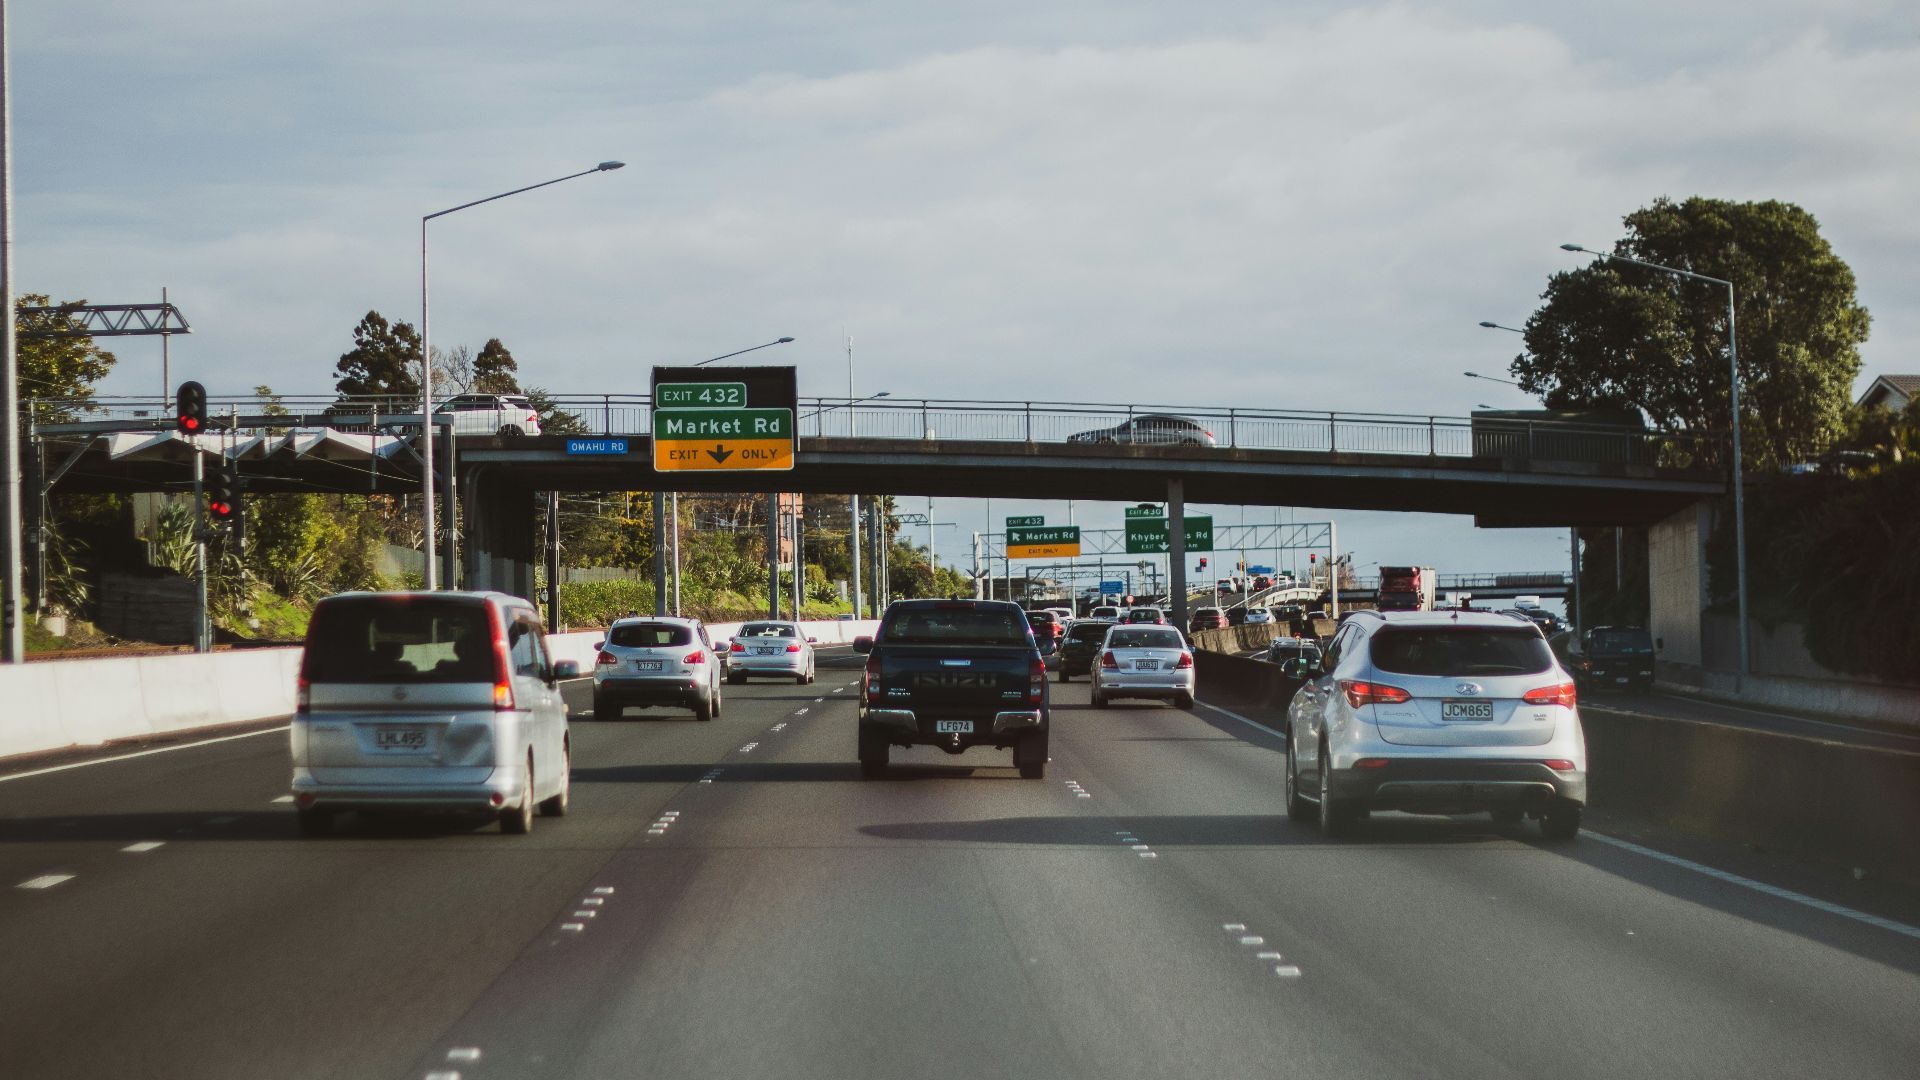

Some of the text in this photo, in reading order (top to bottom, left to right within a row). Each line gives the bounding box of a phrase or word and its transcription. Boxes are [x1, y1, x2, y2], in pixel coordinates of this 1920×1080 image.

[663, 388, 739, 403] EXIT 432
[666, 417, 780, 434] Market Rd
[571, 442, 624, 451] OMAHU RD
[669, 448, 778, 460] EXIT ONLY
[1024, 517, 1042, 525] 432
[1026, 531, 1074, 540] Market Rd
[1131, 533, 1164, 541] Khyber
[1196, 531, 1208, 539] Rd
[913, 672, 997, 689] ISUZU
[1444, 704, 1491, 717] JCM865
[940, 722, 970, 732] LFG74
[377, 732, 424, 745] LHL495
